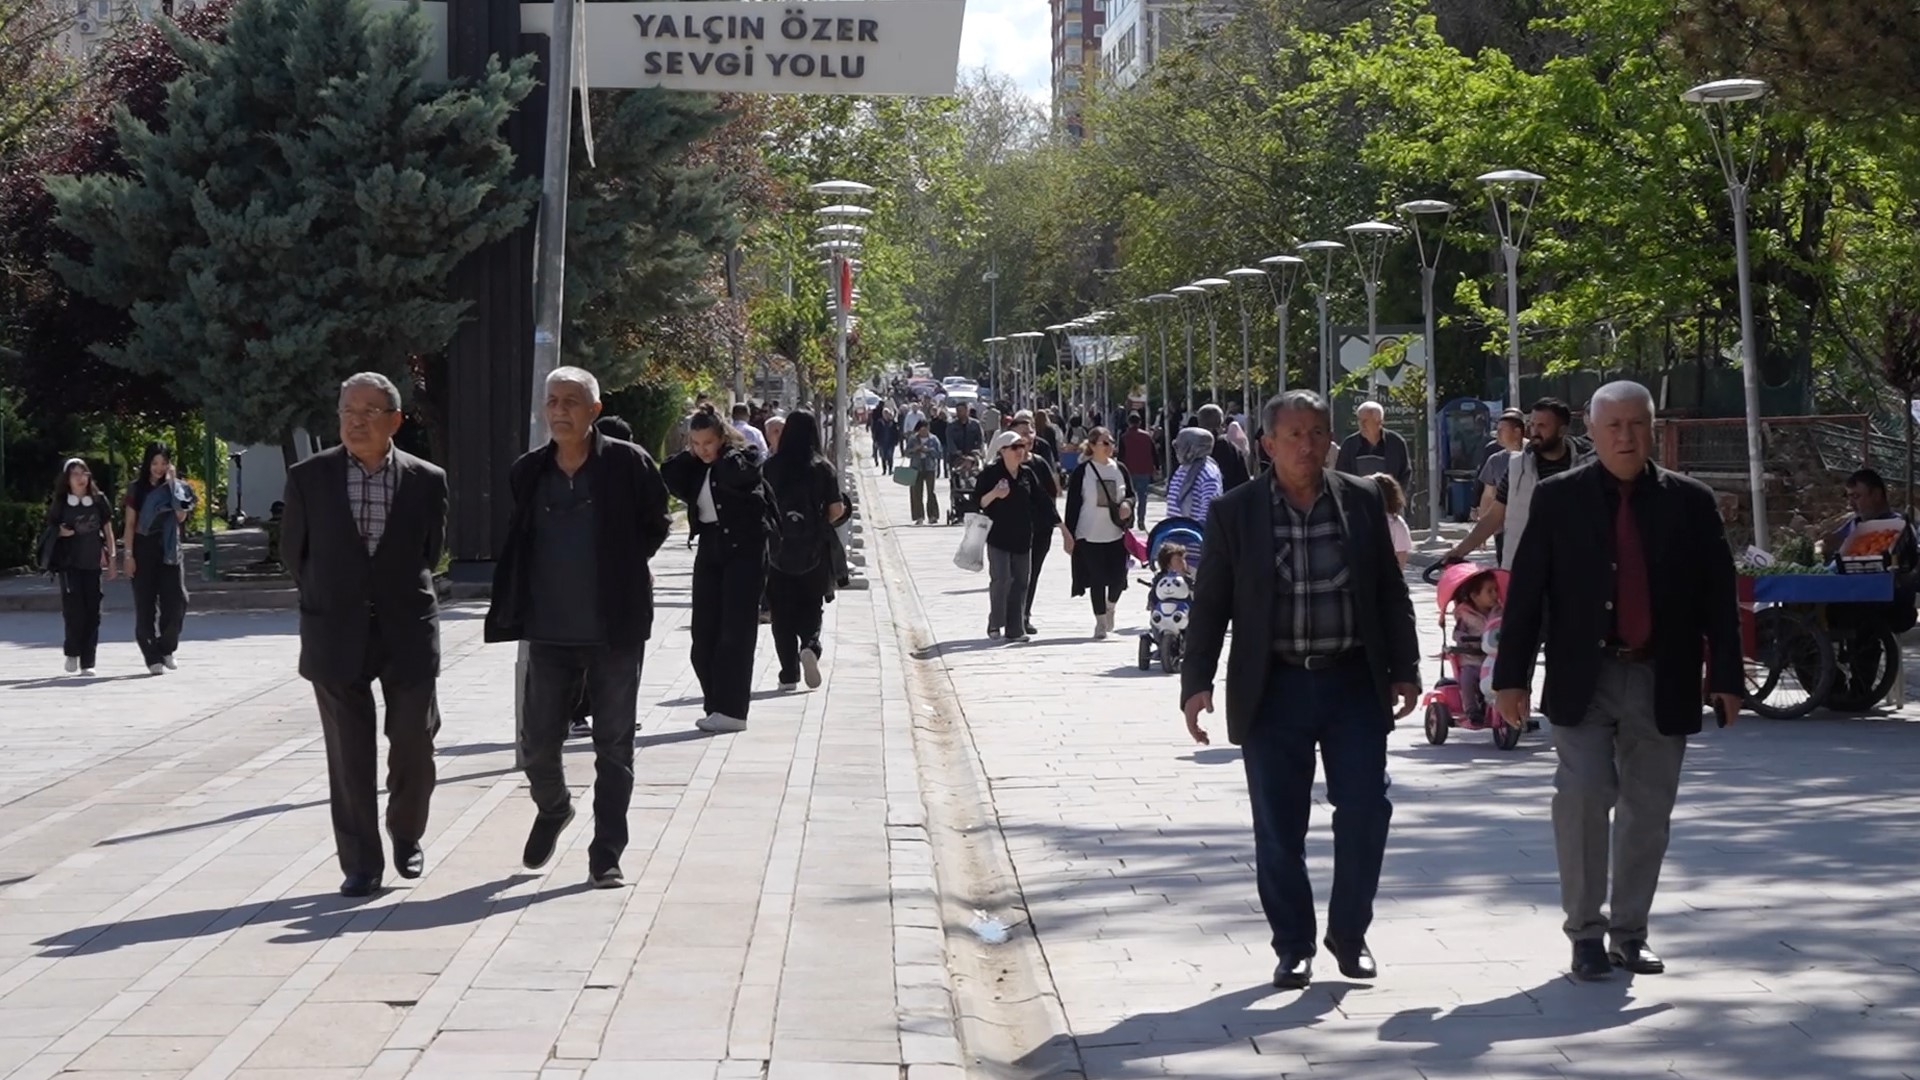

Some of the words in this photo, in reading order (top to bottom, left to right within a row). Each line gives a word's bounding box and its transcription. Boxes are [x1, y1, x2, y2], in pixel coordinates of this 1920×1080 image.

[633, 14, 764, 44] YALÇIN
[780, 9, 879, 42] ÖZER
[644, 45, 754, 77] SEVGİ
[766, 53, 865, 78] YOLU
